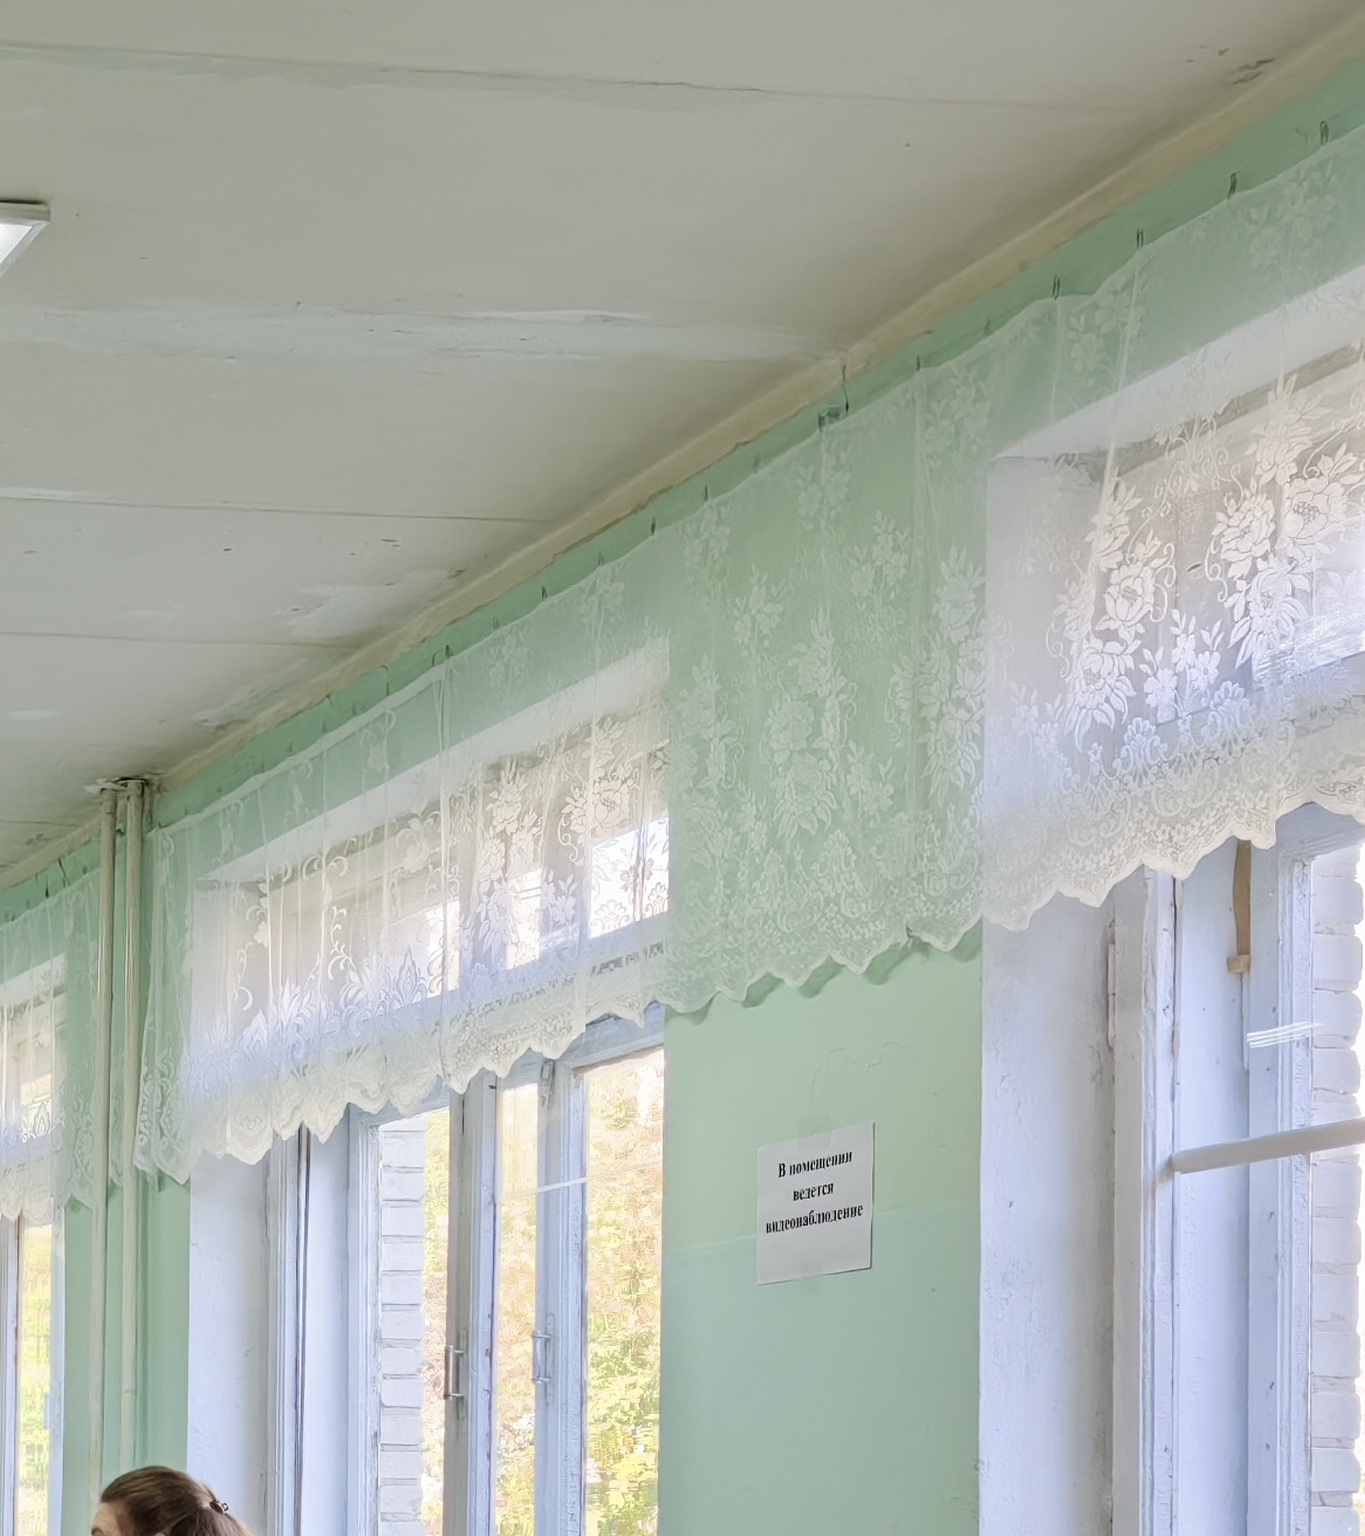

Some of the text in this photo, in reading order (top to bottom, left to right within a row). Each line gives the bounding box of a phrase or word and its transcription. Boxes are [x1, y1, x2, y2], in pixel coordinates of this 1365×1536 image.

[778, 1151, 853, 1178] В помещении
[793, 1183, 834, 1201] ведется
[766, 1204, 864, 1234] видеонаблюдение
